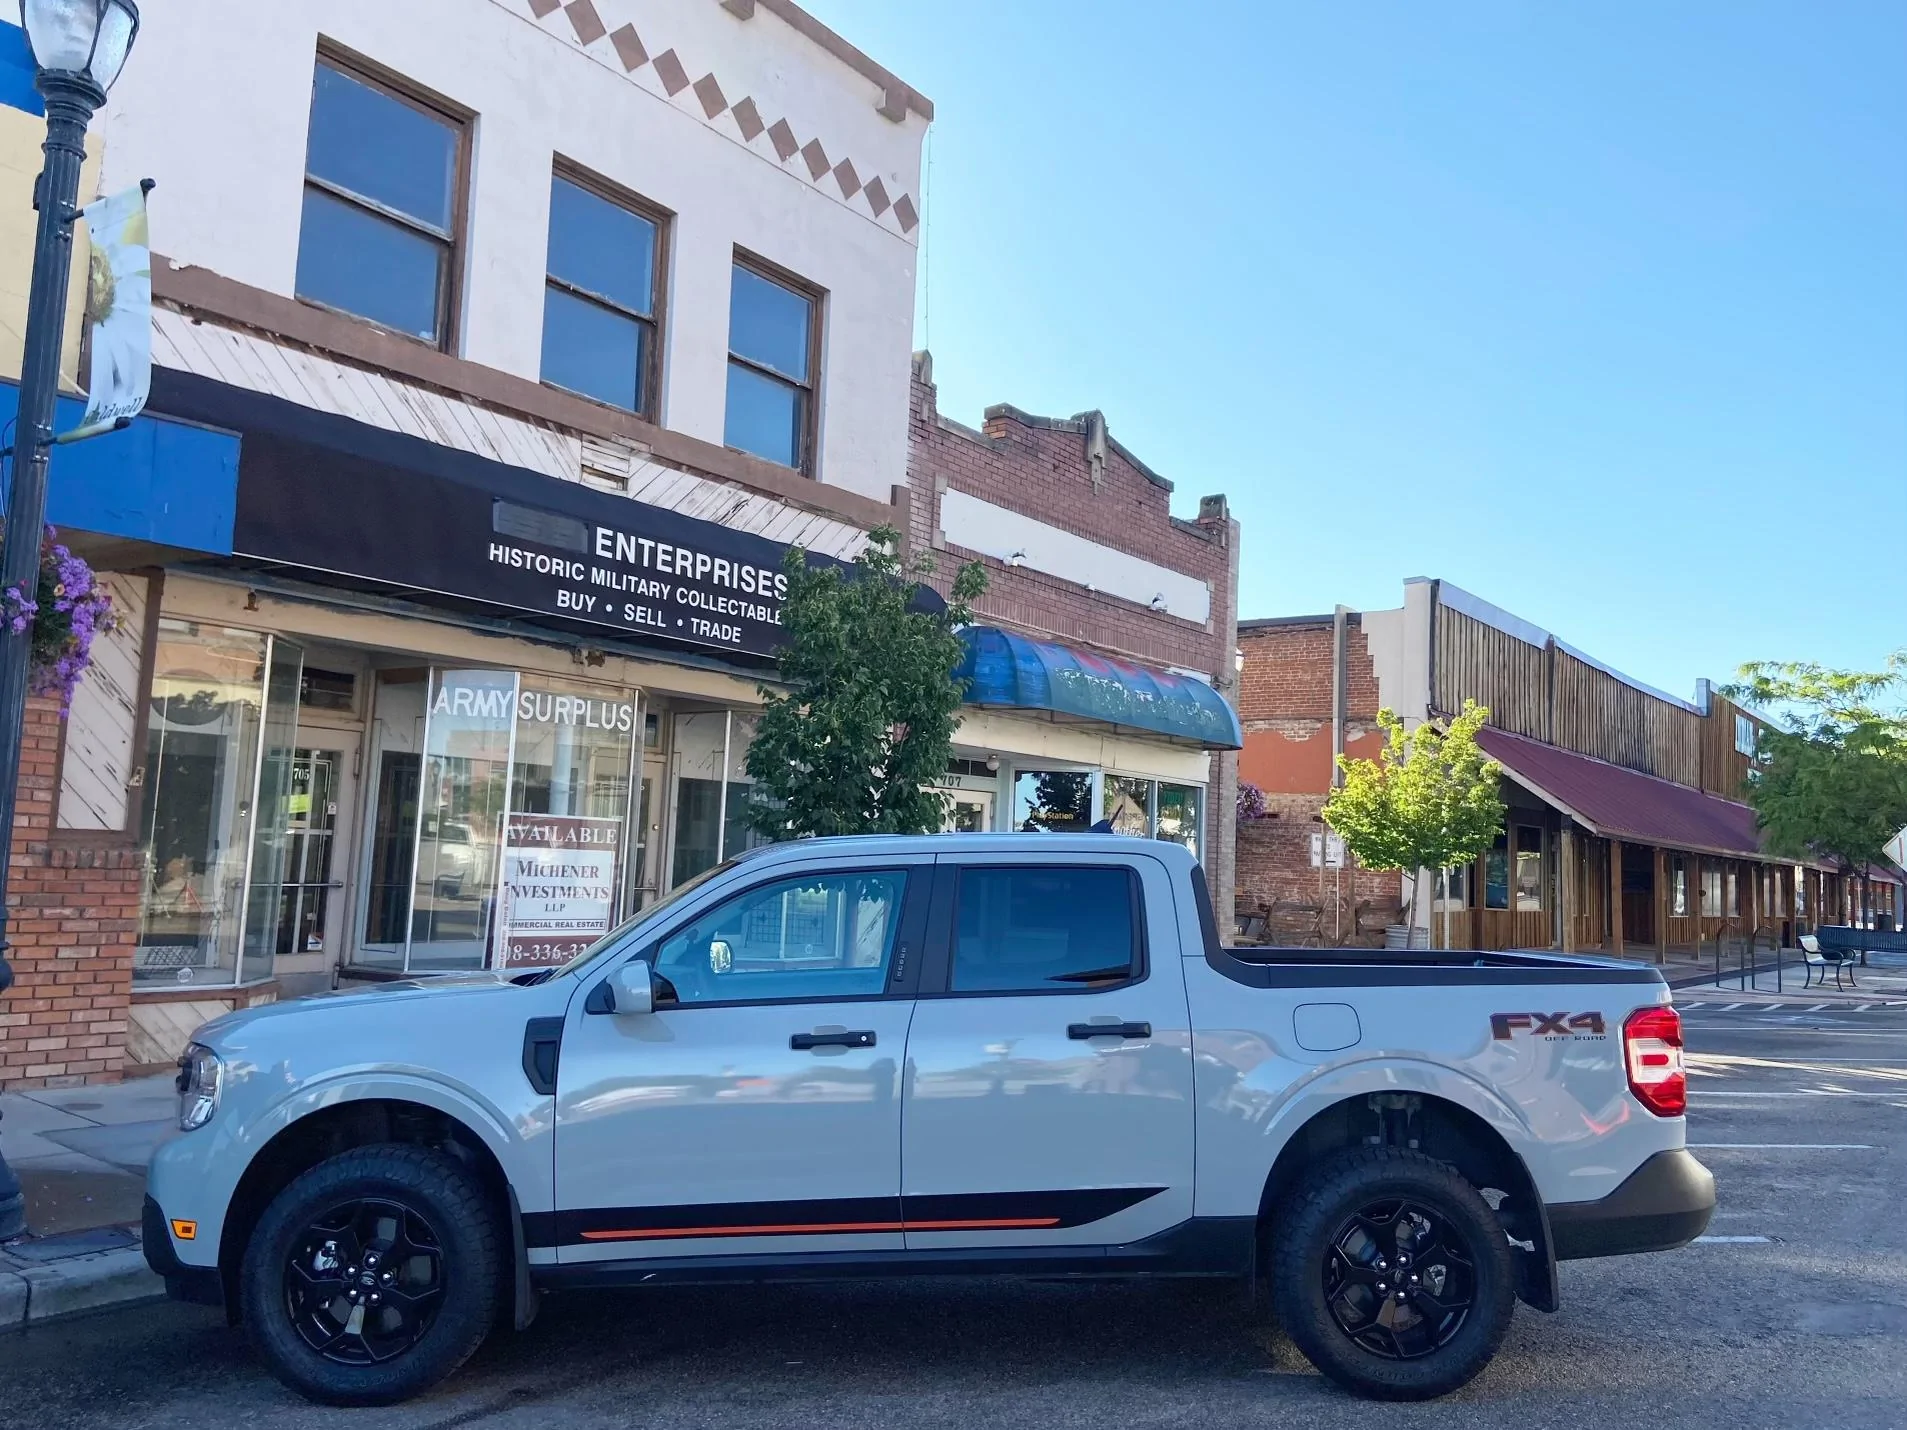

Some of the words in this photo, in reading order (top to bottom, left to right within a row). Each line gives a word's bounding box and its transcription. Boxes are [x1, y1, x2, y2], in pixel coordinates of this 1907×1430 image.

[489, 543, 585, 581] HISTORIC
[591, 566, 671, 601] MILITARY
[595, 526, 788, 601] ENTERPRISES
[556, 589, 596, 613] BUY
[623, 604, 667, 628] SELL
[690, 617, 742, 643] TRADE
[432, 687, 513, 718] ARMY
[518, 691, 633, 732] SURPLUS
[293, 767, 310, 780] 705
[941, 775, 962, 787] 707
[507, 824, 617, 844] AVAILABLE
[515, 860, 599, 879] MICHENER
[510, 884, 609, 900] NVESTMENTS
[545, 902, 566, 913] LLP
[509, 921, 552, 930] MMERCIAL
[555, 921, 575, 929] REAL
[576, 920, 605, 928] ESTATE
[1490, 1011, 1605, 1040] FX4
